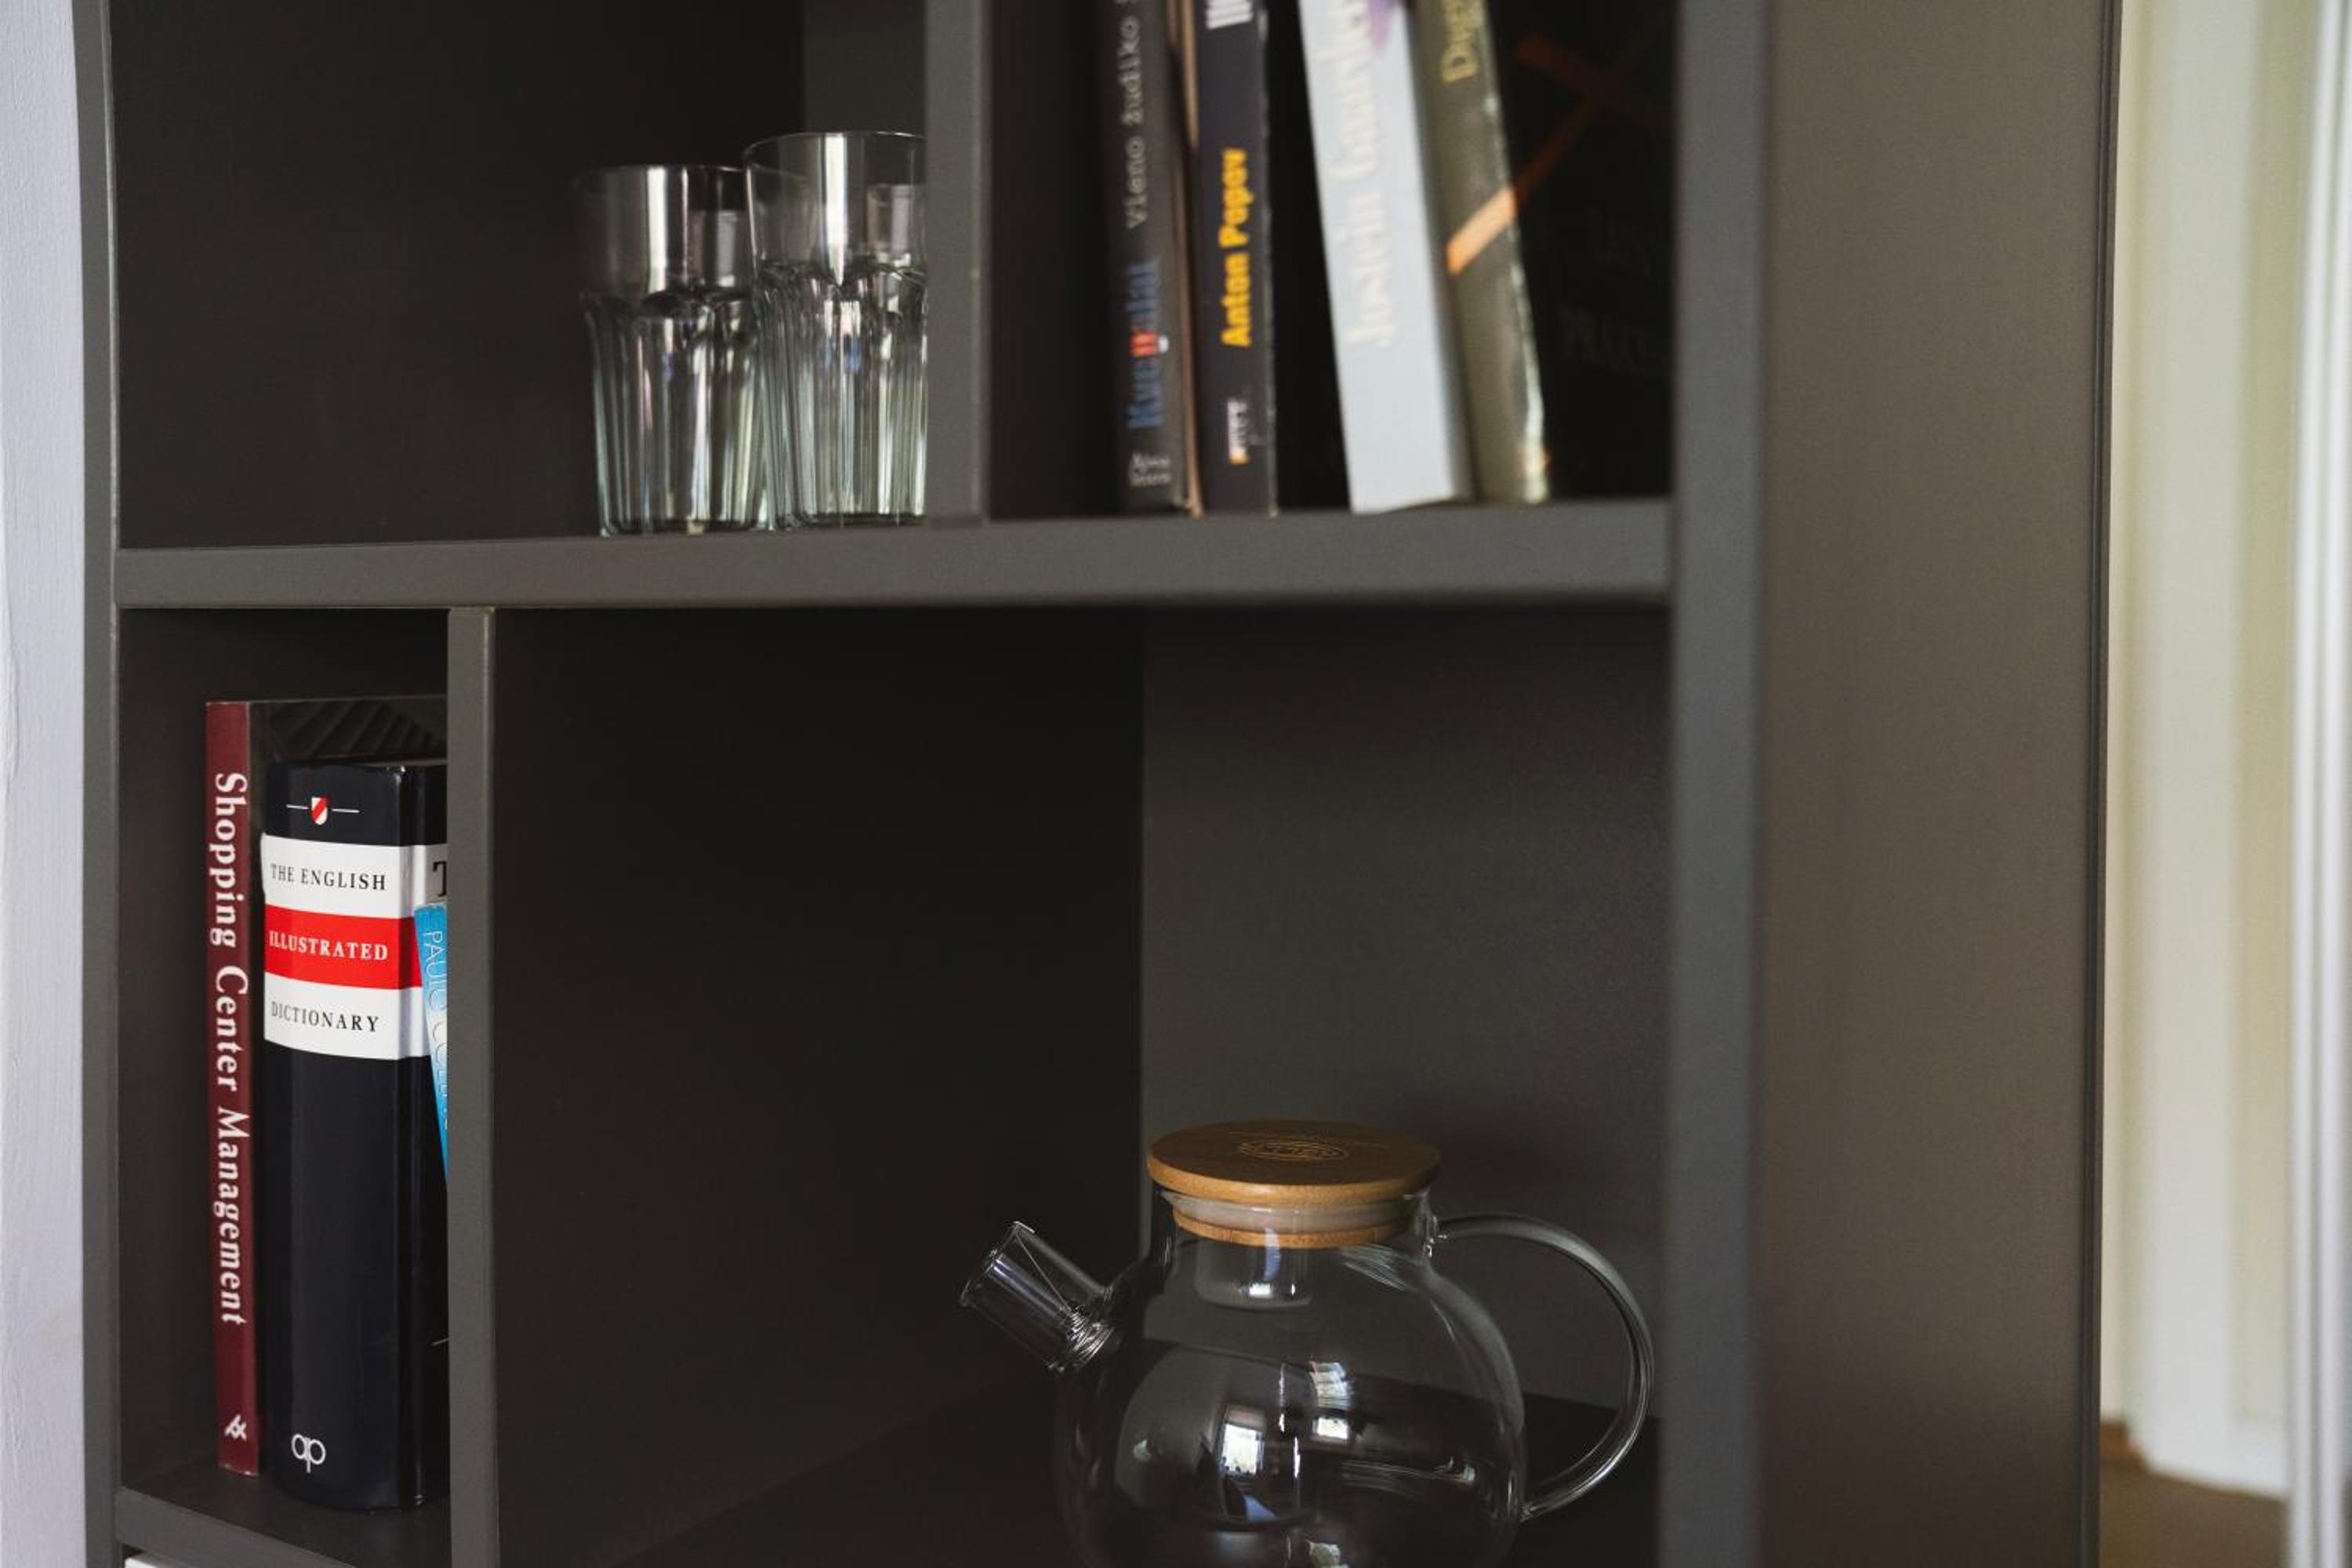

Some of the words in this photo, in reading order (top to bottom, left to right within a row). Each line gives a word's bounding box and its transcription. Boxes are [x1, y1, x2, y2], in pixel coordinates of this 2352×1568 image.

[1218, 147, 1254, 249] Popov
[1219, 252, 1254, 348] Anton
[208, 771, 249, 948] Shopping
[270, 863, 295, 883] THE
[300, 868, 387, 891] ENGLISH
[268, 931, 389, 961] ILLUSTRATED
[214, 964, 250, 1092] Center
[270, 1000, 379, 1033] DICTIONARY
[212, 1105, 251, 1327] Management
